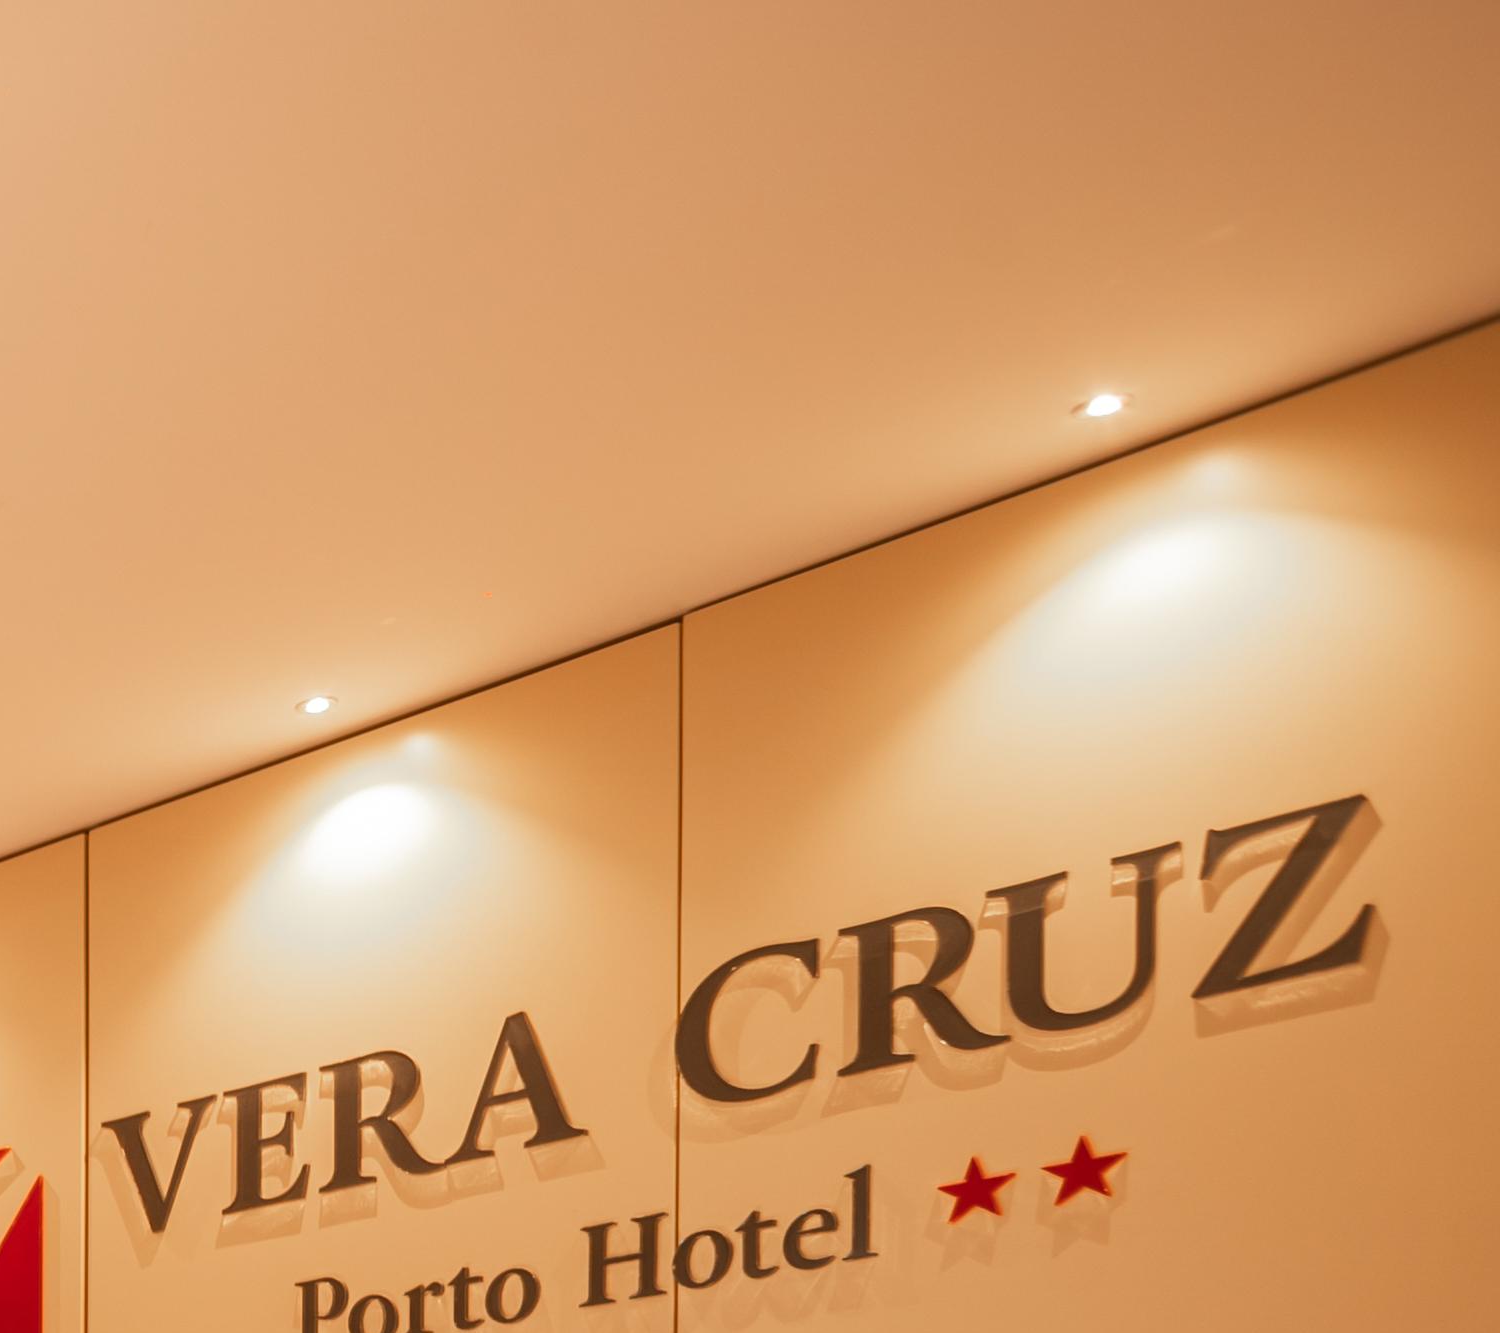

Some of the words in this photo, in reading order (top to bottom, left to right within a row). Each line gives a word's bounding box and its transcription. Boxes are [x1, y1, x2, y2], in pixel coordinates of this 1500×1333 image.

[99, 1010, 590, 1235] VERA
[672, 793, 1380, 1107] CRUZ
[578, 1164, 881, 1311] Hotel
